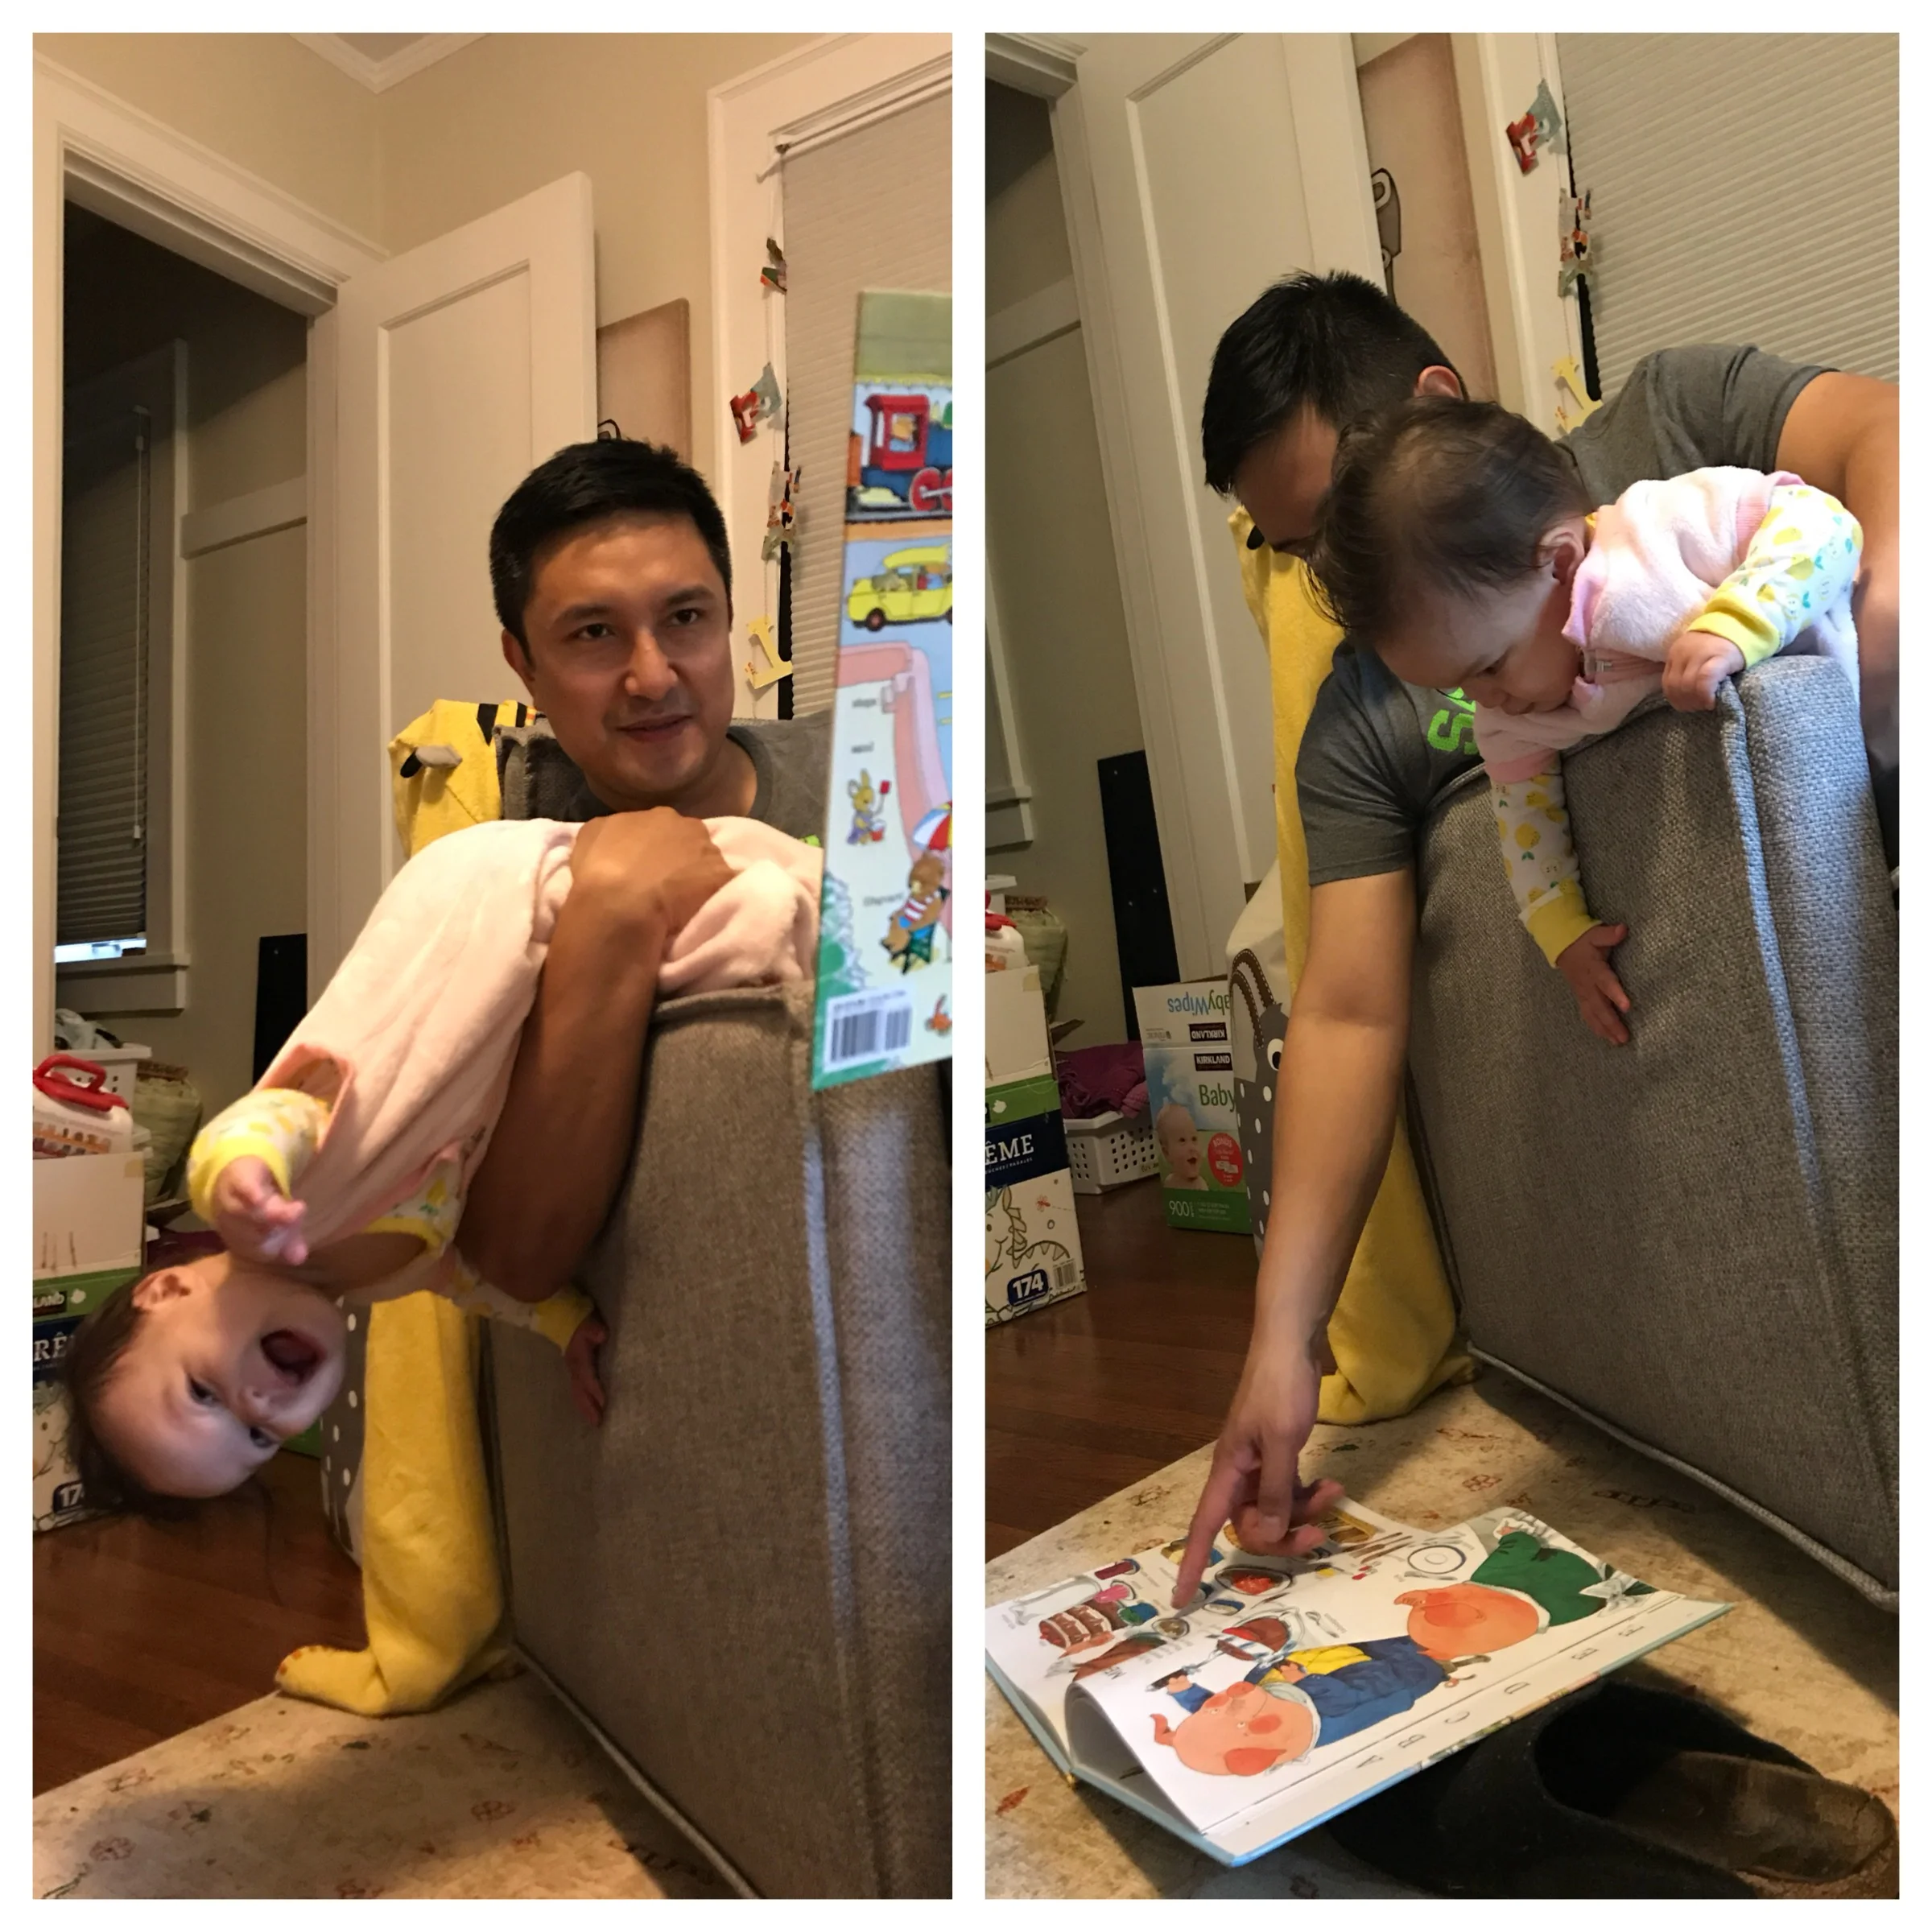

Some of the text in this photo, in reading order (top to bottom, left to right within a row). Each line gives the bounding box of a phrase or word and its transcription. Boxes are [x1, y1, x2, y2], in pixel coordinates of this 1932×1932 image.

[1195, 1055, 1231, 1065] KIRKLAND
[1199, 1083, 1235, 1113] Baby
[1169, 1200, 1190, 1217] 900
[1013, 1272, 1044, 1298] 174
[60, 1483, 85, 1508] 17
